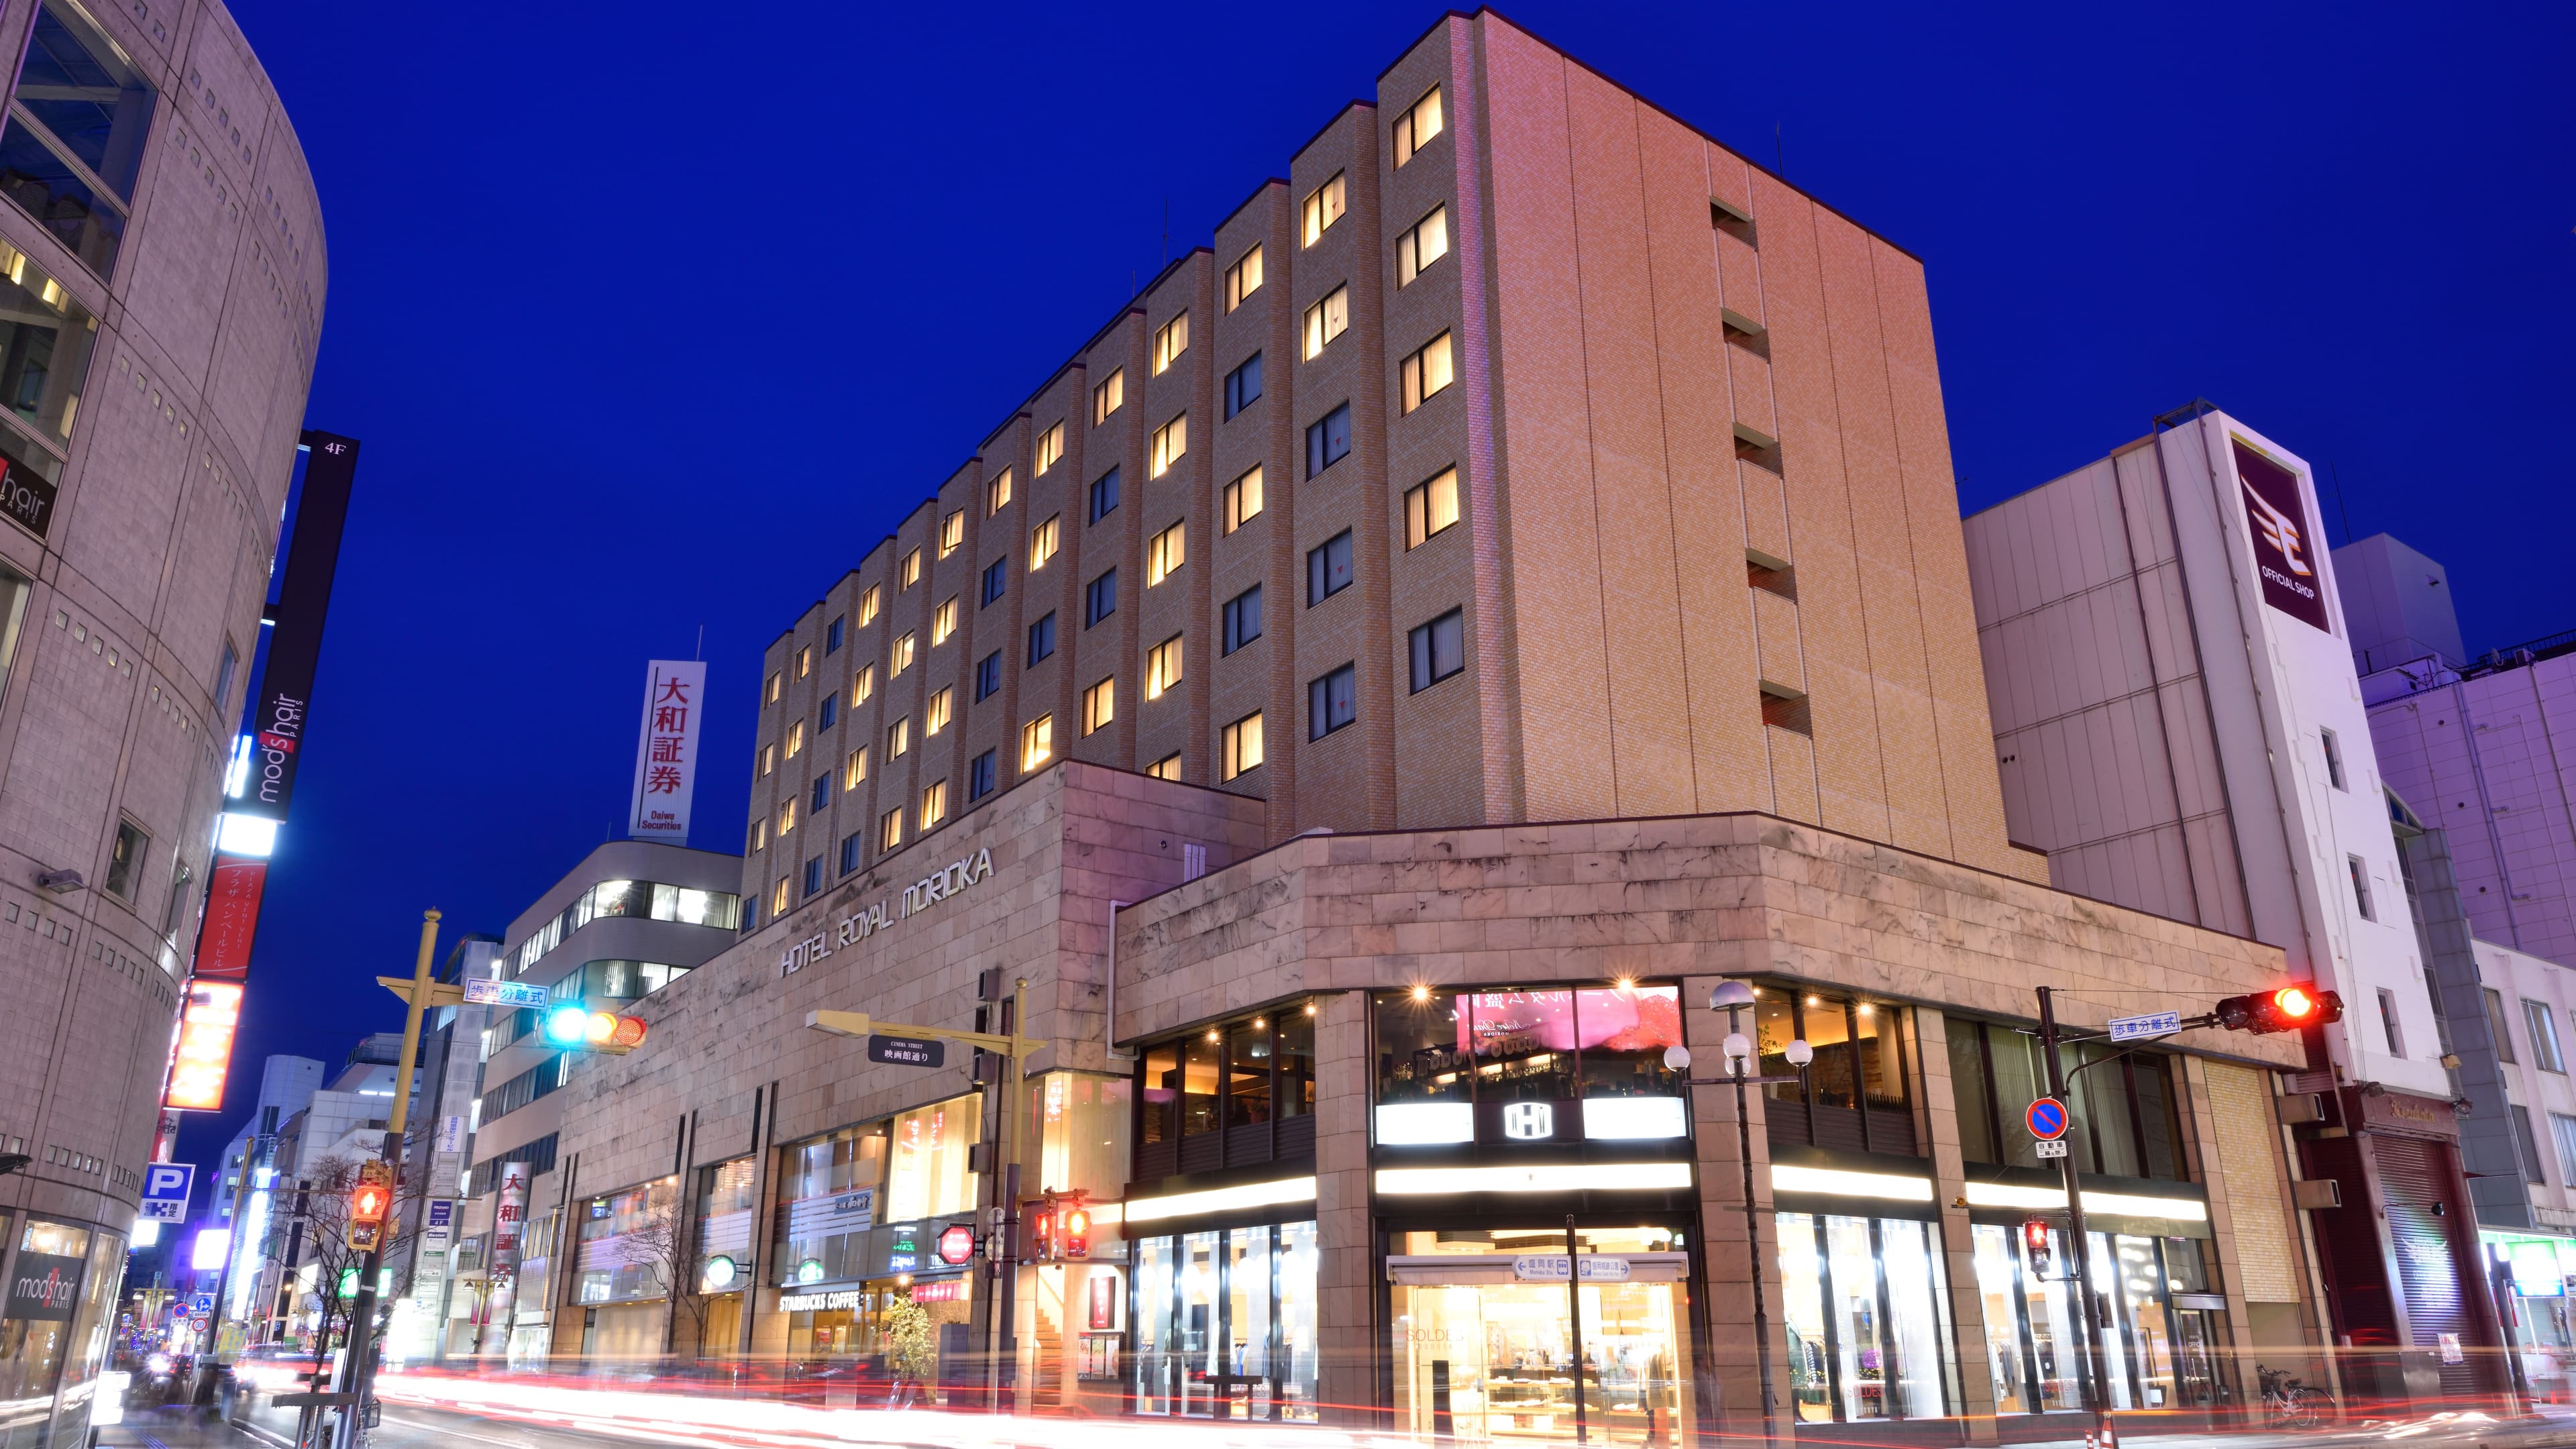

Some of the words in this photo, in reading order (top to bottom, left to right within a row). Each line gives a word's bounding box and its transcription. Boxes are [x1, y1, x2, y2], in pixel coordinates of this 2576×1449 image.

[325, 442, 347, 455] 4F
[1, 468, 45, 516] hair
[0, 493, 37, 525] PARIS
[2261, 565, 2295, 591] OFFICIAL
[2295, 581, 2314, 600] SHOP
[289, 700, 303, 738] PARIS
[647, 677, 690, 794] 大和証券
[642, 820, 682, 830] Securities
[651, 810, 675, 820] Daiwa
[780, 931, 833, 978] HOTEL
[838, 900, 895, 950] ROYAL
[901, 847, 995, 920] MORIOKA
[471, 985, 543, 1004] 歩車分離式
[2114, 1016, 2176, 1036] 歩車分離式
[884, 1049, 928, 1062] 映画館通り
[149, 1169, 184, 1196] P
[168, 1203, 178, 1218] 指定
[495, 1174, 525, 1282] 大和証券
[1529, 1259, 1554, 1269] 盛岡駅
[51, 1300, 69, 1309] PARIS
[779, 1293, 826, 1312] STARBUCKS
[827, 1291, 859, 1309] COFFEE
[195, 1321, 205, 1329] 30
